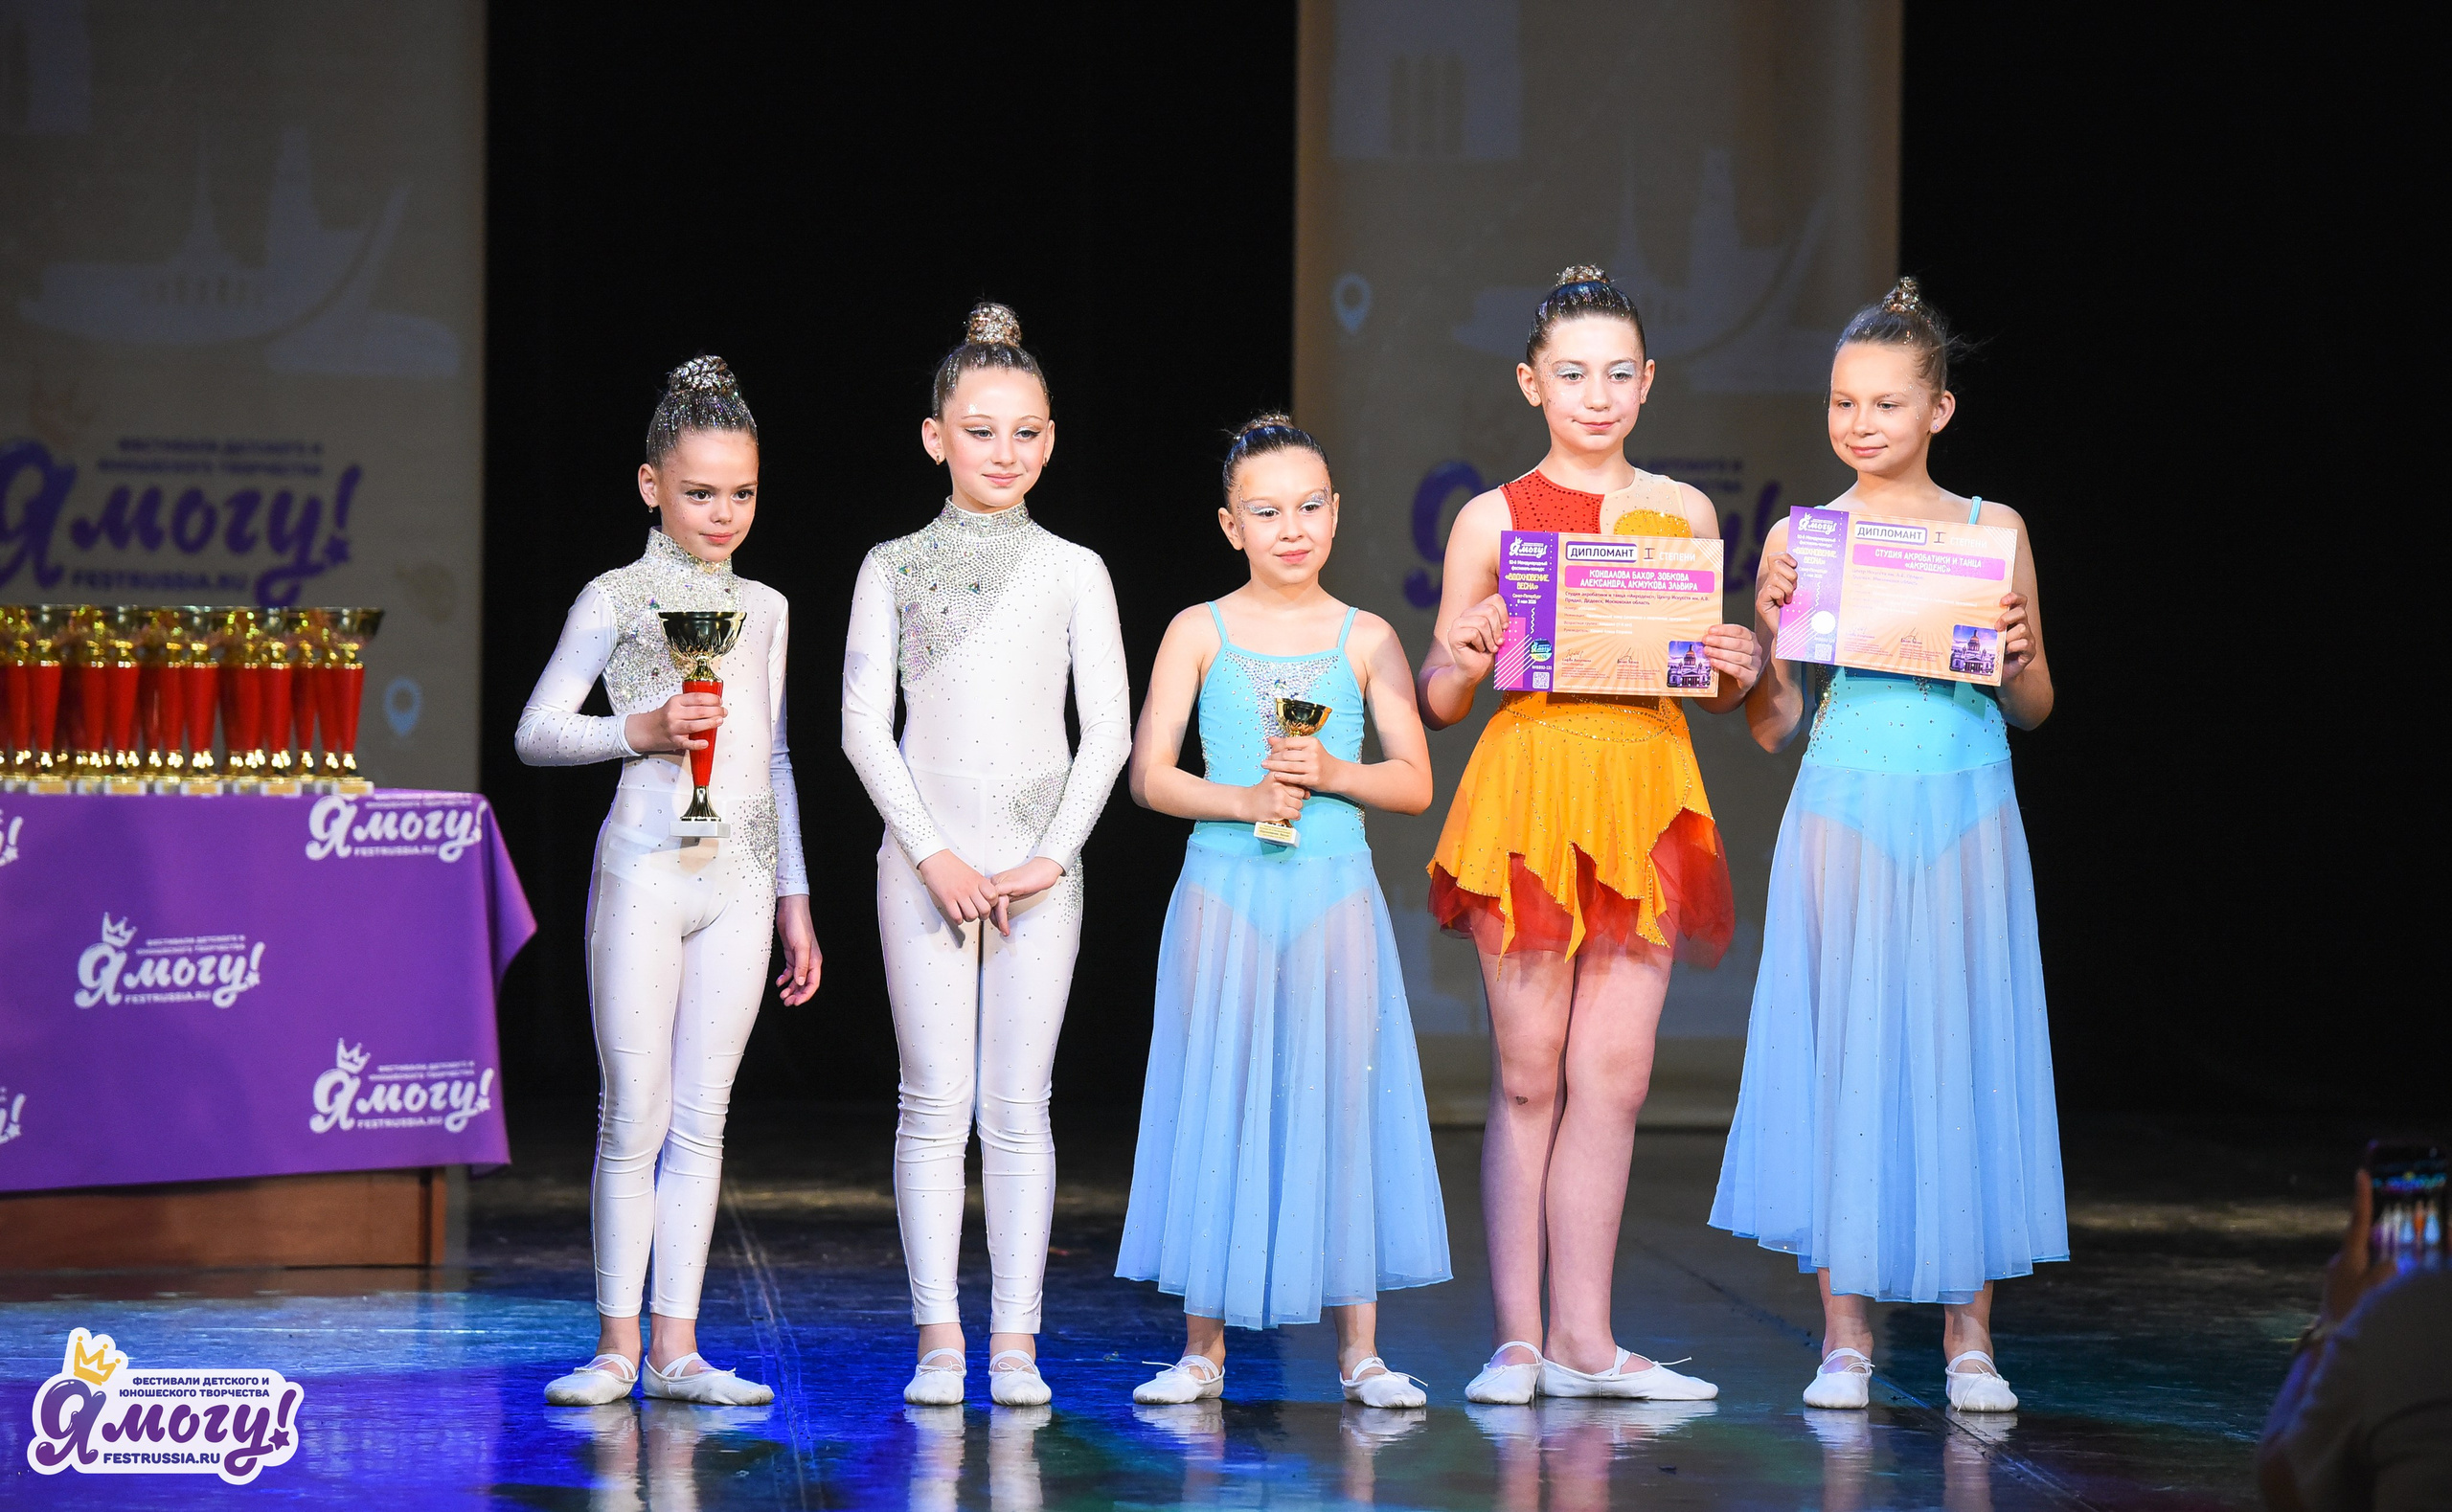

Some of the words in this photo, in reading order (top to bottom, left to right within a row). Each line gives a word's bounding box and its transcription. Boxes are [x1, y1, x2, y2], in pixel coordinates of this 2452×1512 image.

[71, 464, 362, 606] могу!
[1857, 527, 1922, 540] ДИПЛОМАНТ
[1950, 537, 1987, 549] СТЕПЕНИ
[1570, 547, 1634, 558] ДИПЛОМАНТ
[1644, 548, 1655, 559] I
[1659, 552, 1696, 561] СТЕПЕНИ
[1874, 549, 1902, 559] СТУДИЯ
[1904, 553, 1951, 565] АКРОБАТИКИ
[1960, 557, 1982, 568] ТАНЦА
[1589, 569, 1630, 579] КОНДАЛОВА
[1632, 570, 1656, 580] БАХОР,
[1657, 572, 1689, 581] ЗОБКОВА
[1904, 562, 1951, 574] «АКРОДЕНС»
[1579, 578, 1627, 589] АЛЕКСАНДРА,
[1627, 580, 1667, 590] АКМУКОВА
[1668, 581, 1698, 591] ЭЛЬВИРА
[306, 796, 357, 860] Я
[353, 801, 487, 863] могу!
[75, 942, 126, 1008] Я
[123, 941, 265, 1008] могу!
[309, 1068, 360, 1134] Я
[355, 1068, 494, 1133] могу!
